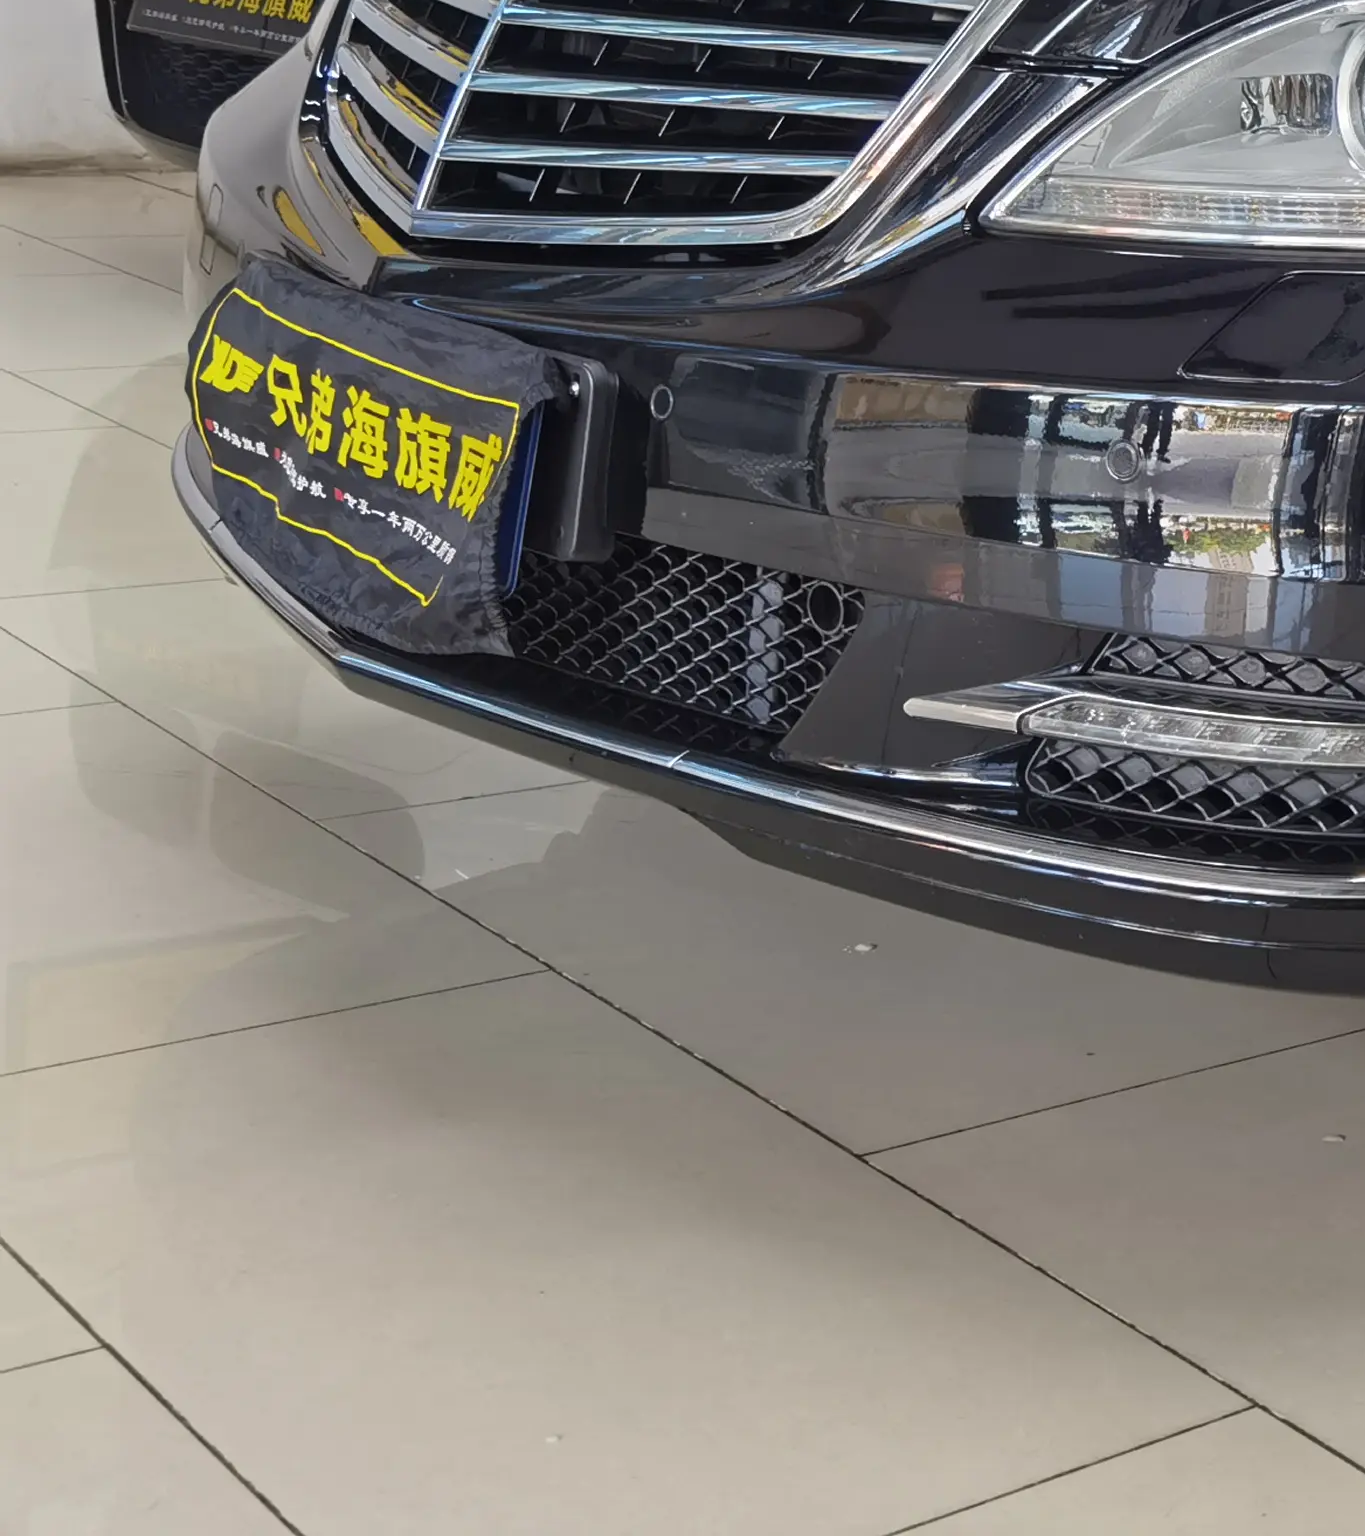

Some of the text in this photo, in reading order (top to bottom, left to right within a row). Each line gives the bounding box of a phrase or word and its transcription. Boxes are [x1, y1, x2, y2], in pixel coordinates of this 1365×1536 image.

[266, 354, 504, 523] 兄弟海旗威
